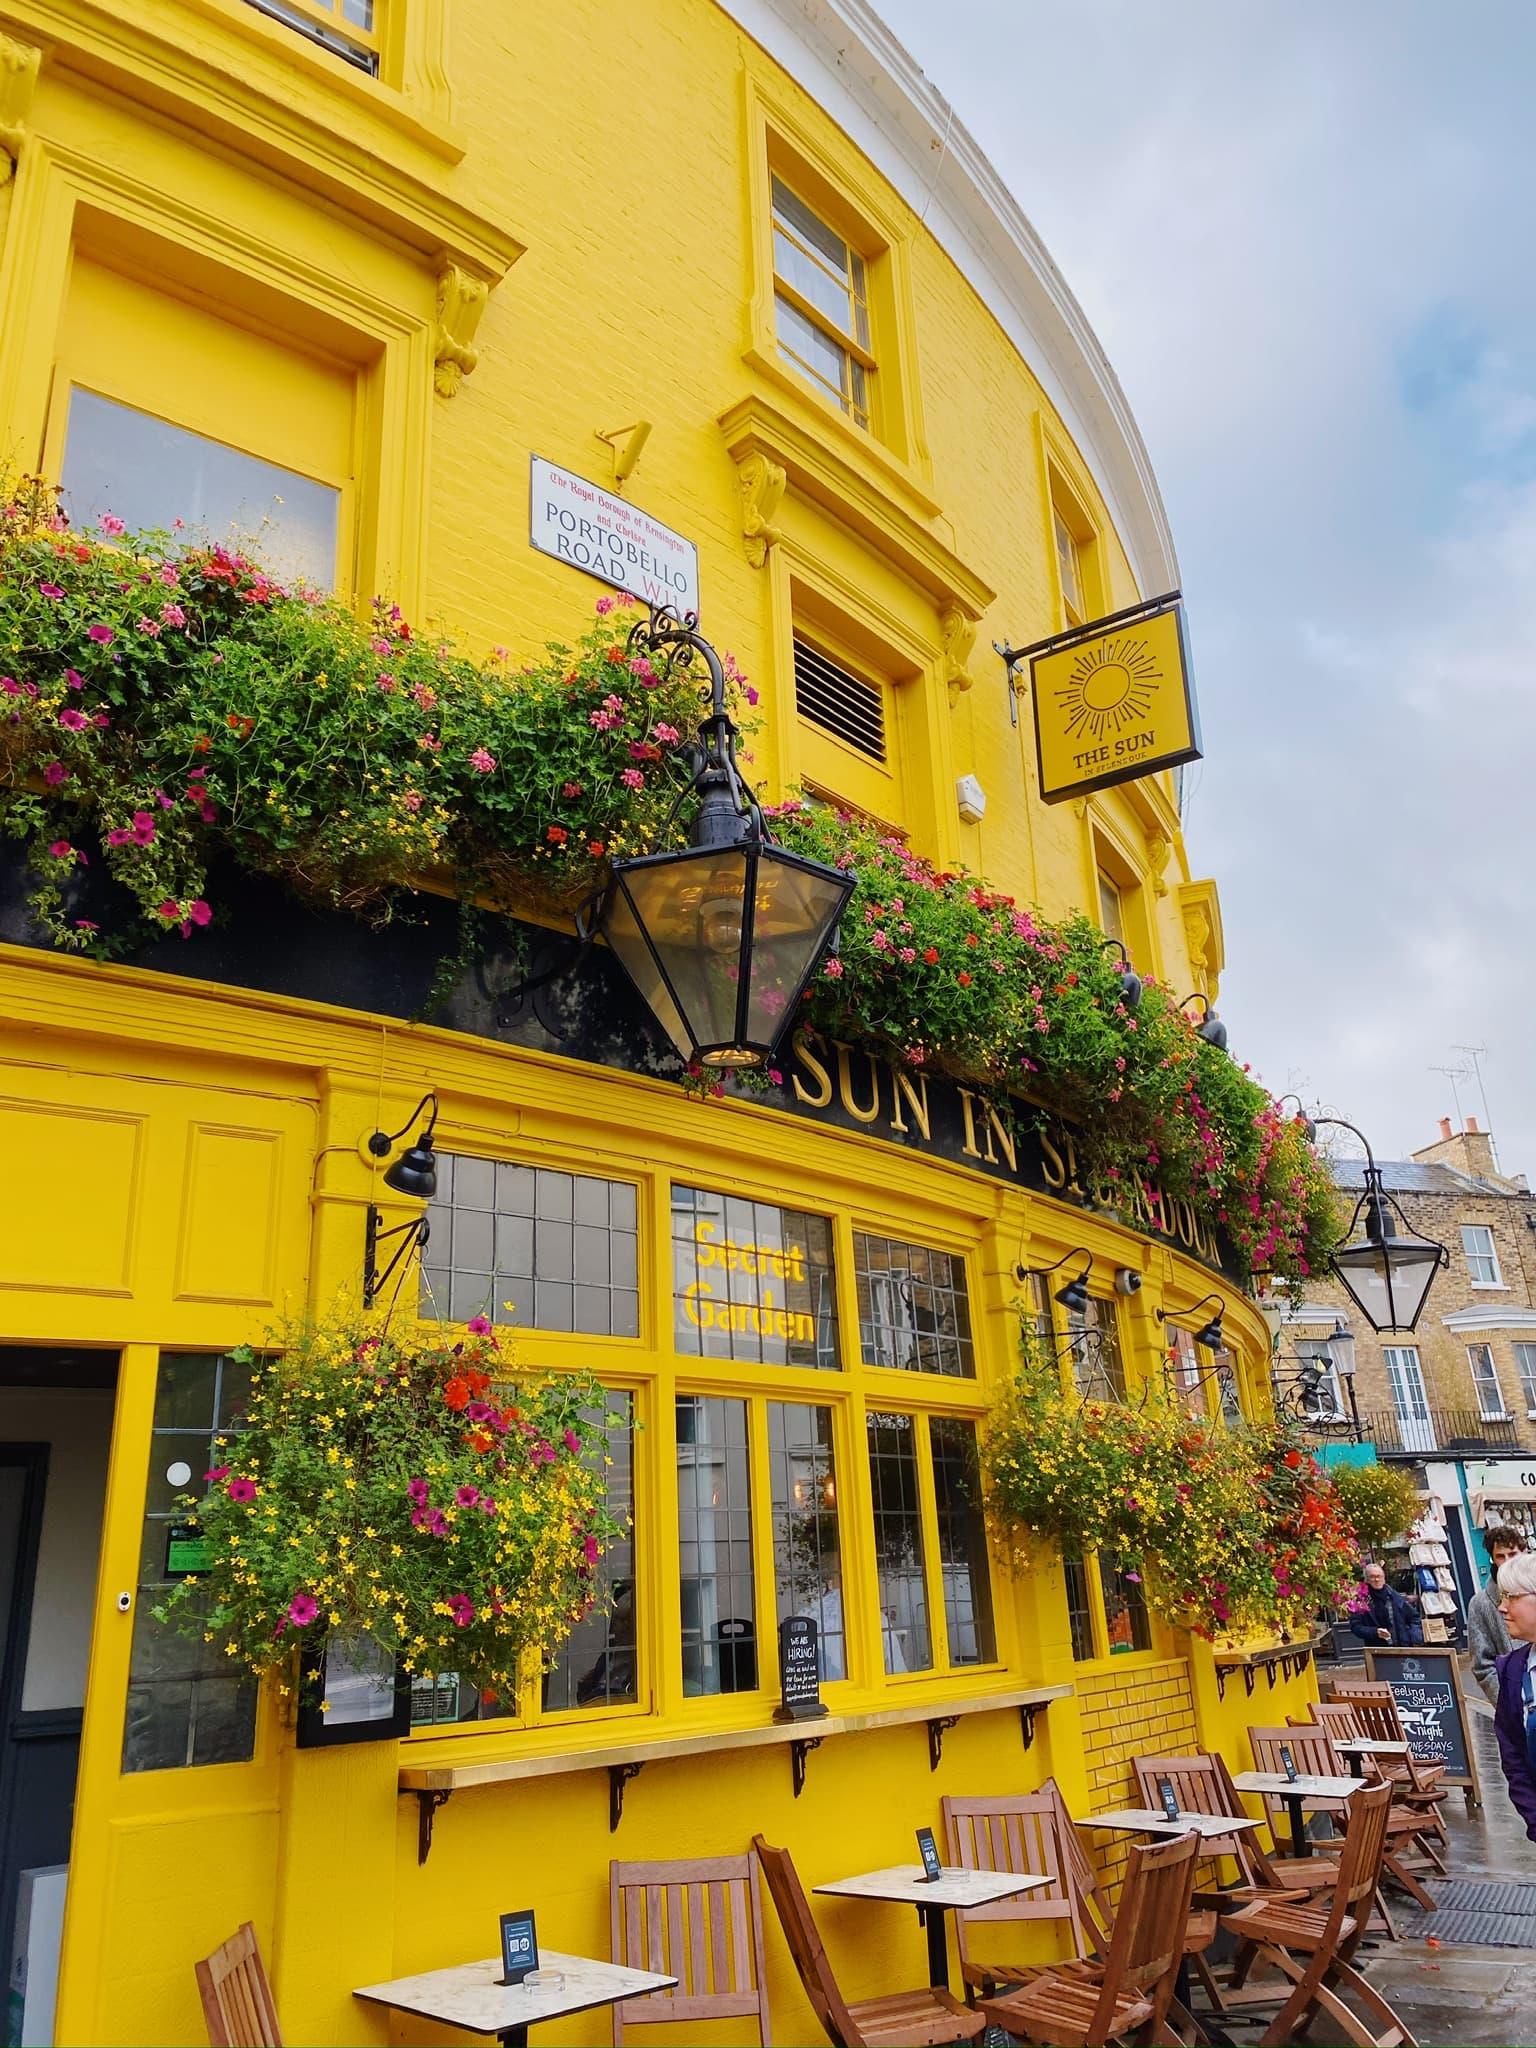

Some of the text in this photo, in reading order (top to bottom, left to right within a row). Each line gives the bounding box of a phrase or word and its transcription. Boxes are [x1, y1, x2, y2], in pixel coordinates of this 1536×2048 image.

[550, 472, 685, 555] The Royal Borough of Kensington
[597, 513, 646, 547] and Chelsea
[546, 501, 688, 593] PORTOBELLO
[1073, 730, 1155, 769] THE SUN
[1084, 752, 1147, 777] IN SPLENDOUR
[792, 1029, 931, 1140] SUN
[957, 1086, 1018, 1172] IN
[696, 1222, 804, 1281] Secret
[686, 1282, 815, 1342] Garden
[1416, 1726, 1443, 1741] night
